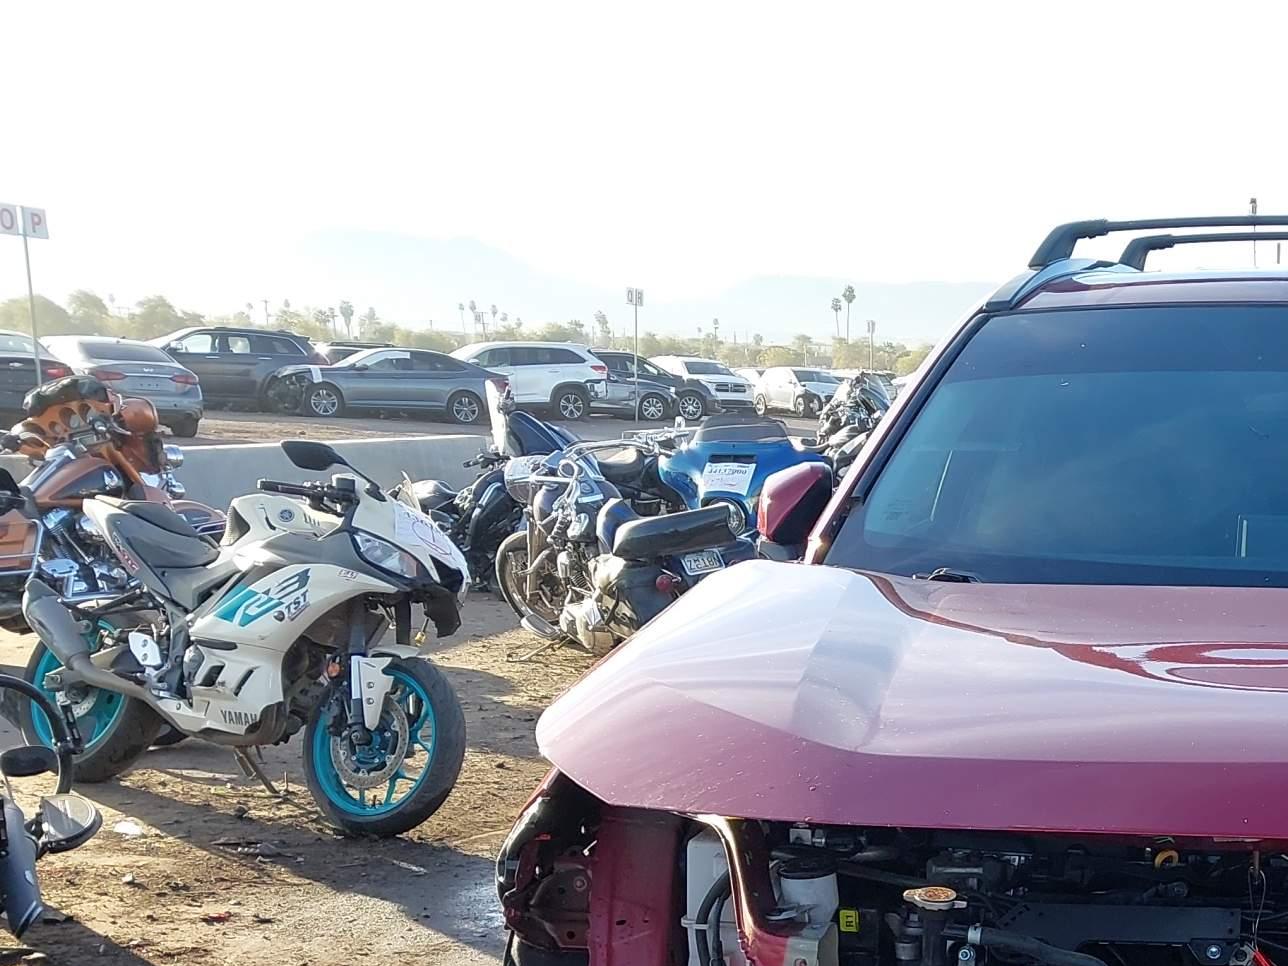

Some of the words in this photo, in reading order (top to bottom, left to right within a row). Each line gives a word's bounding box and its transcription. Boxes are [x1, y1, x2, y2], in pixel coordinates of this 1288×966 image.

[0, 208, 14, 230] O
[30, 212, 42, 233] P
[285, 589, 309, 614] TST
[220, 710, 258, 726] YAMAH
